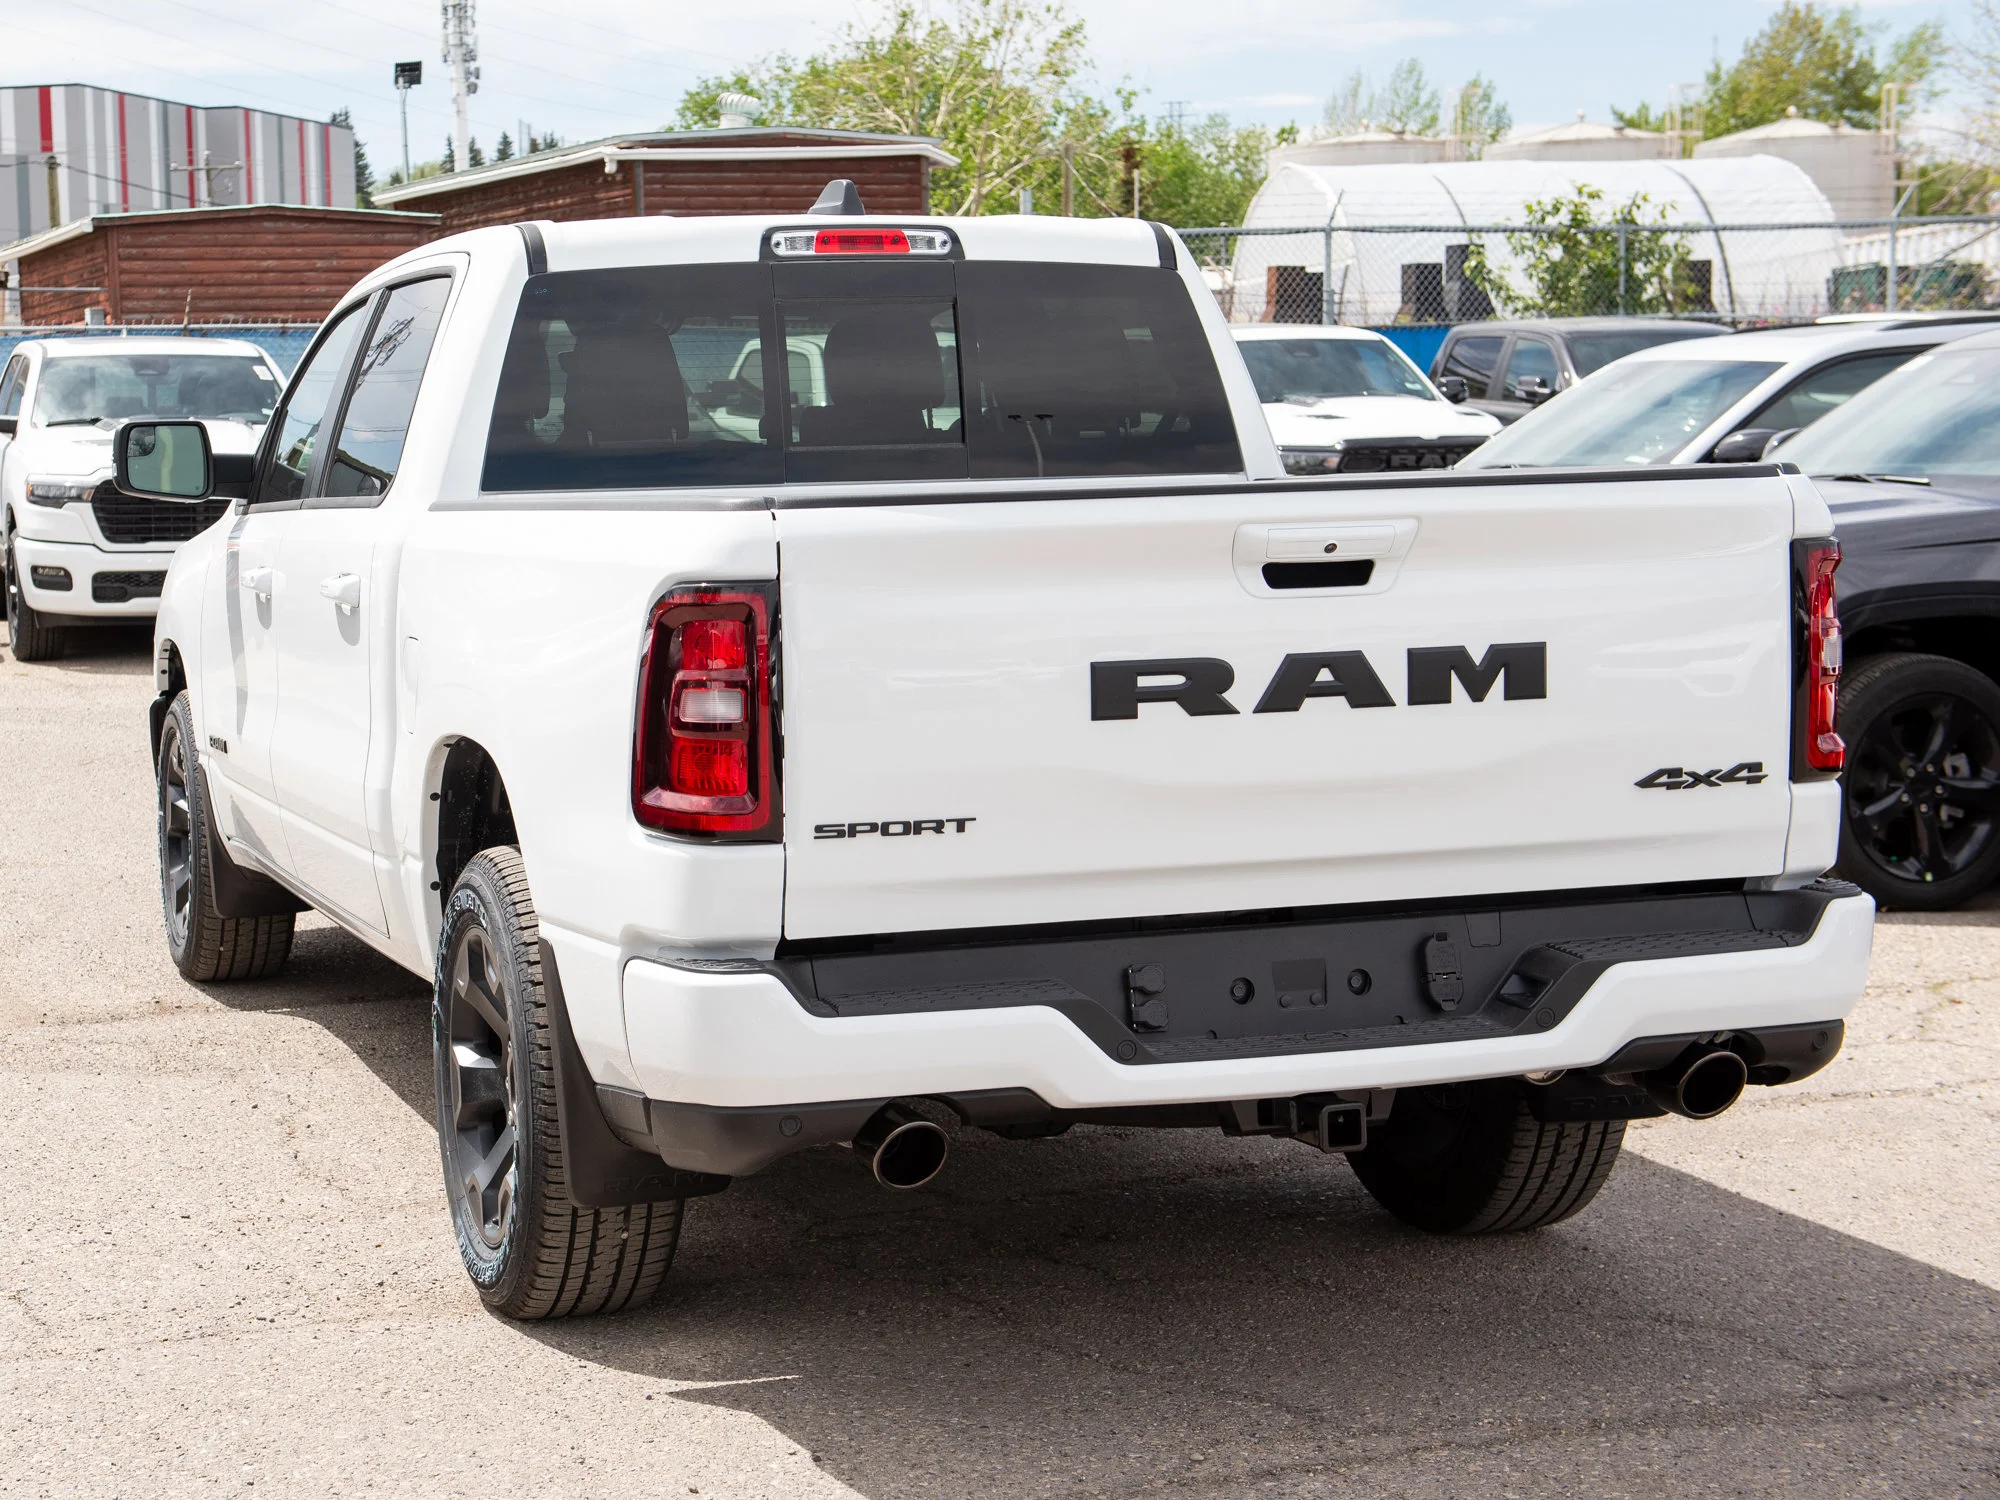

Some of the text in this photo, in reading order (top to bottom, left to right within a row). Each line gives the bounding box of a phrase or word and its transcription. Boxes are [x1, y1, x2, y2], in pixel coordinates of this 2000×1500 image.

[1090, 642, 1547, 721] RAM
[1634, 762, 1768, 790] 4x4
[814, 818, 976, 839] SPORT
